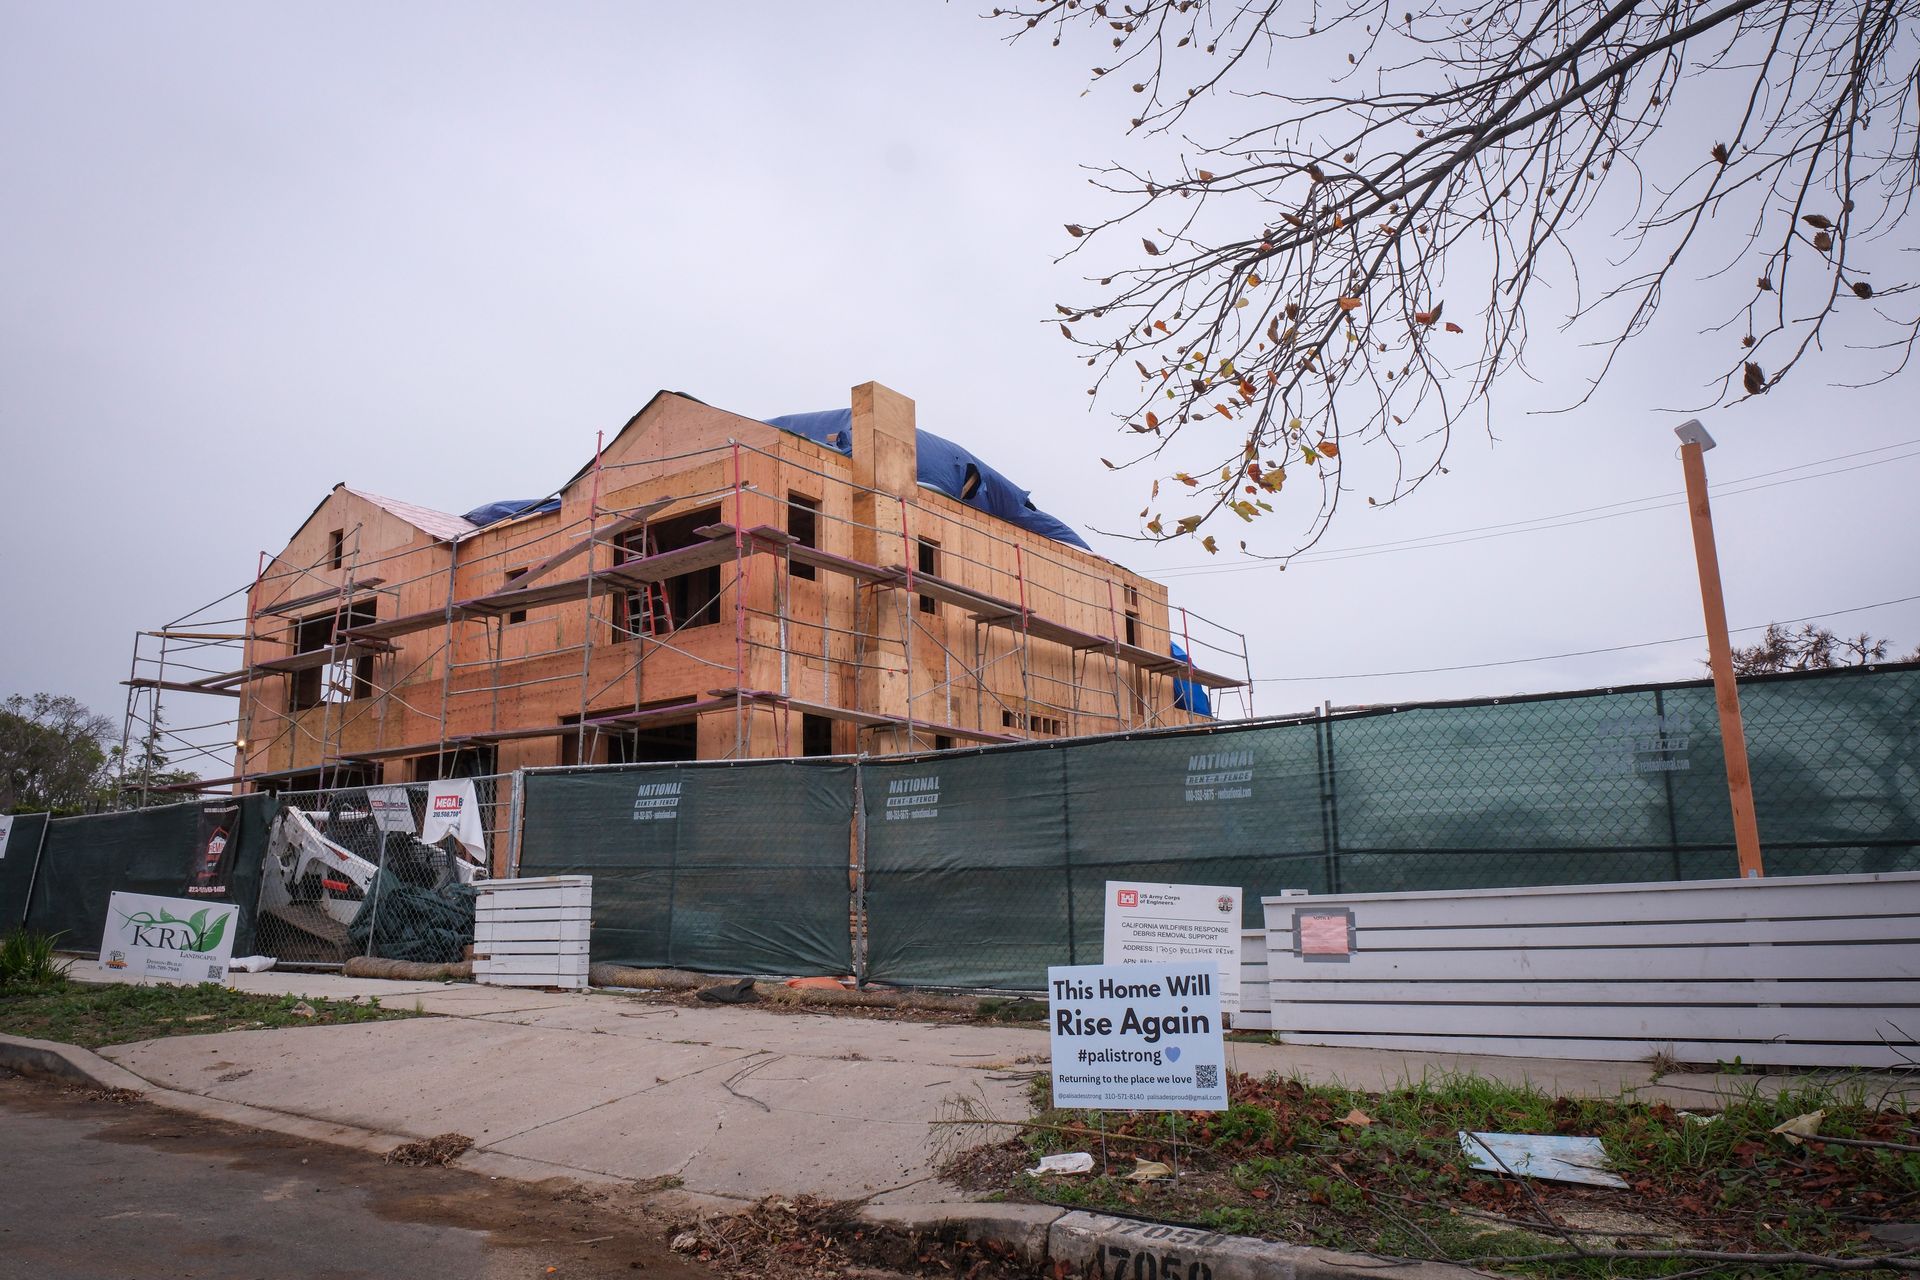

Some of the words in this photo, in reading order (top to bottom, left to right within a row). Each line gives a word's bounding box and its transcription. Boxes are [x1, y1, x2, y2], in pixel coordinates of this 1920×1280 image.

[1188, 750, 1254, 771] NATIONAL
[1187, 771, 1251, 784] RENT-A-FENCE
[637, 782, 682, 796] NATIONAL
[889, 776, 940, 793] NATIONAL
[436, 798, 456, 808] MEGA
[888, 795, 938, 806] RENT-A-FENCE
[1121, 922, 1158, 930] CALIFORNIA
[1194, 925, 1229, 933] RESPONSE
[130, 924, 207, 953] KRM
[1157, 931, 1187, 939] REMOVAL
[1123, 944, 1154, 952] ADDRESS:
[1053, 979, 1094, 1001] This
[1099, 978, 1161, 999] Home
[1165, 973, 1211, 997] Will
[1056, 1008, 1113, 1036] Rise
[1119, 1006, 1210, 1044] Again
[1078, 1048, 1163, 1066] #palistrong
[1059, 1074, 1101, 1085] Returning
[1113, 1075, 1129, 1084] the
[1130, 1075, 1155, 1085] place
[1171, 1075, 1192, 1084] love
[1147, 1093, 1222, 1101] palisadesproud@gmail.com
